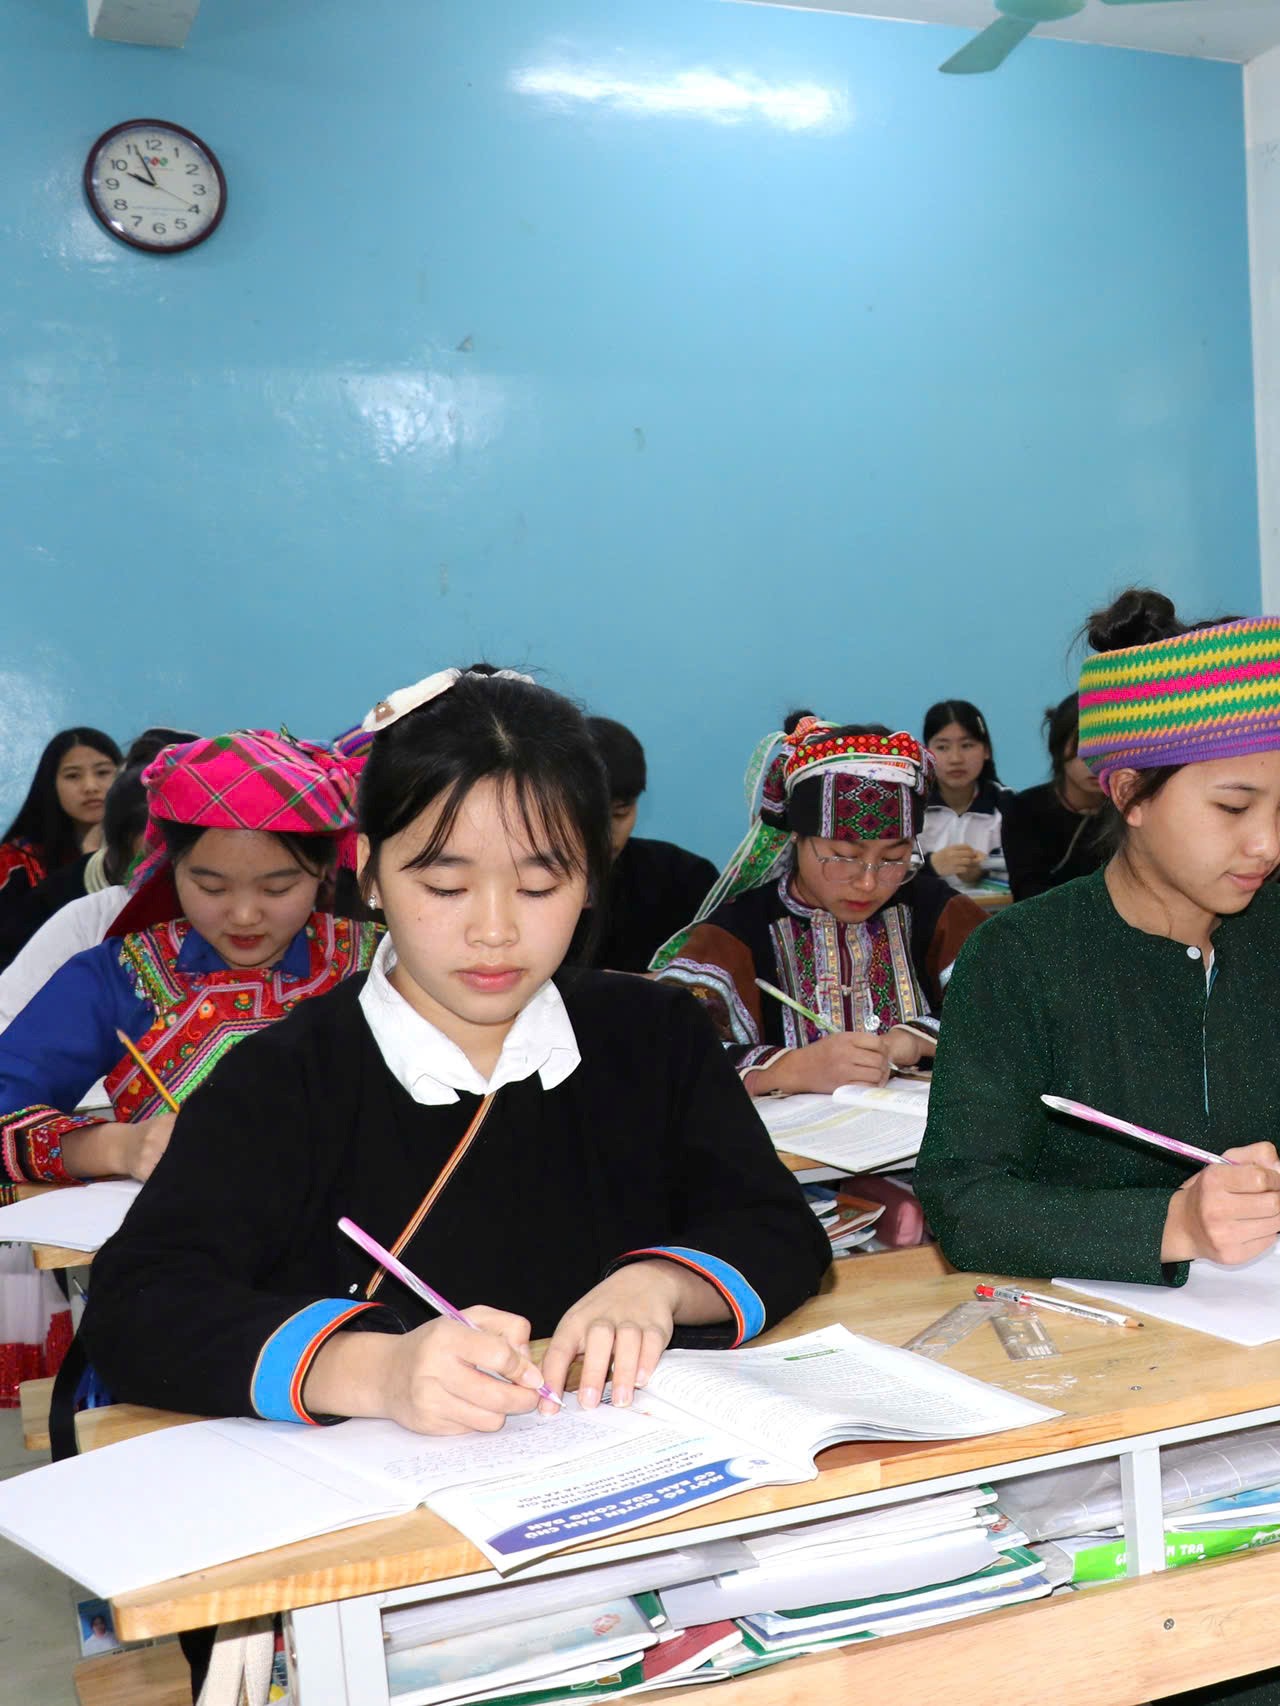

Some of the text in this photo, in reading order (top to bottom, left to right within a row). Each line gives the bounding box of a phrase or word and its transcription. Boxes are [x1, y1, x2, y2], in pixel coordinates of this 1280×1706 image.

[145, 139, 163, 151] 12
[174, 147, 180, 158] 1
[110, 159, 128, 171] 10
[185, 164, 199, 176] 2
[105, 178, 120, 190] 9
[192, 184, 207, 196] 3
[113, 199, 128, 211] 8
[187, 204, 200, 214] 4
[131, 215, 143, 227] 7
[174, 218, 188, 230] 5
[152, 223, 167, 235] 6
[1180, 1544, 1204, 1555] TRA
